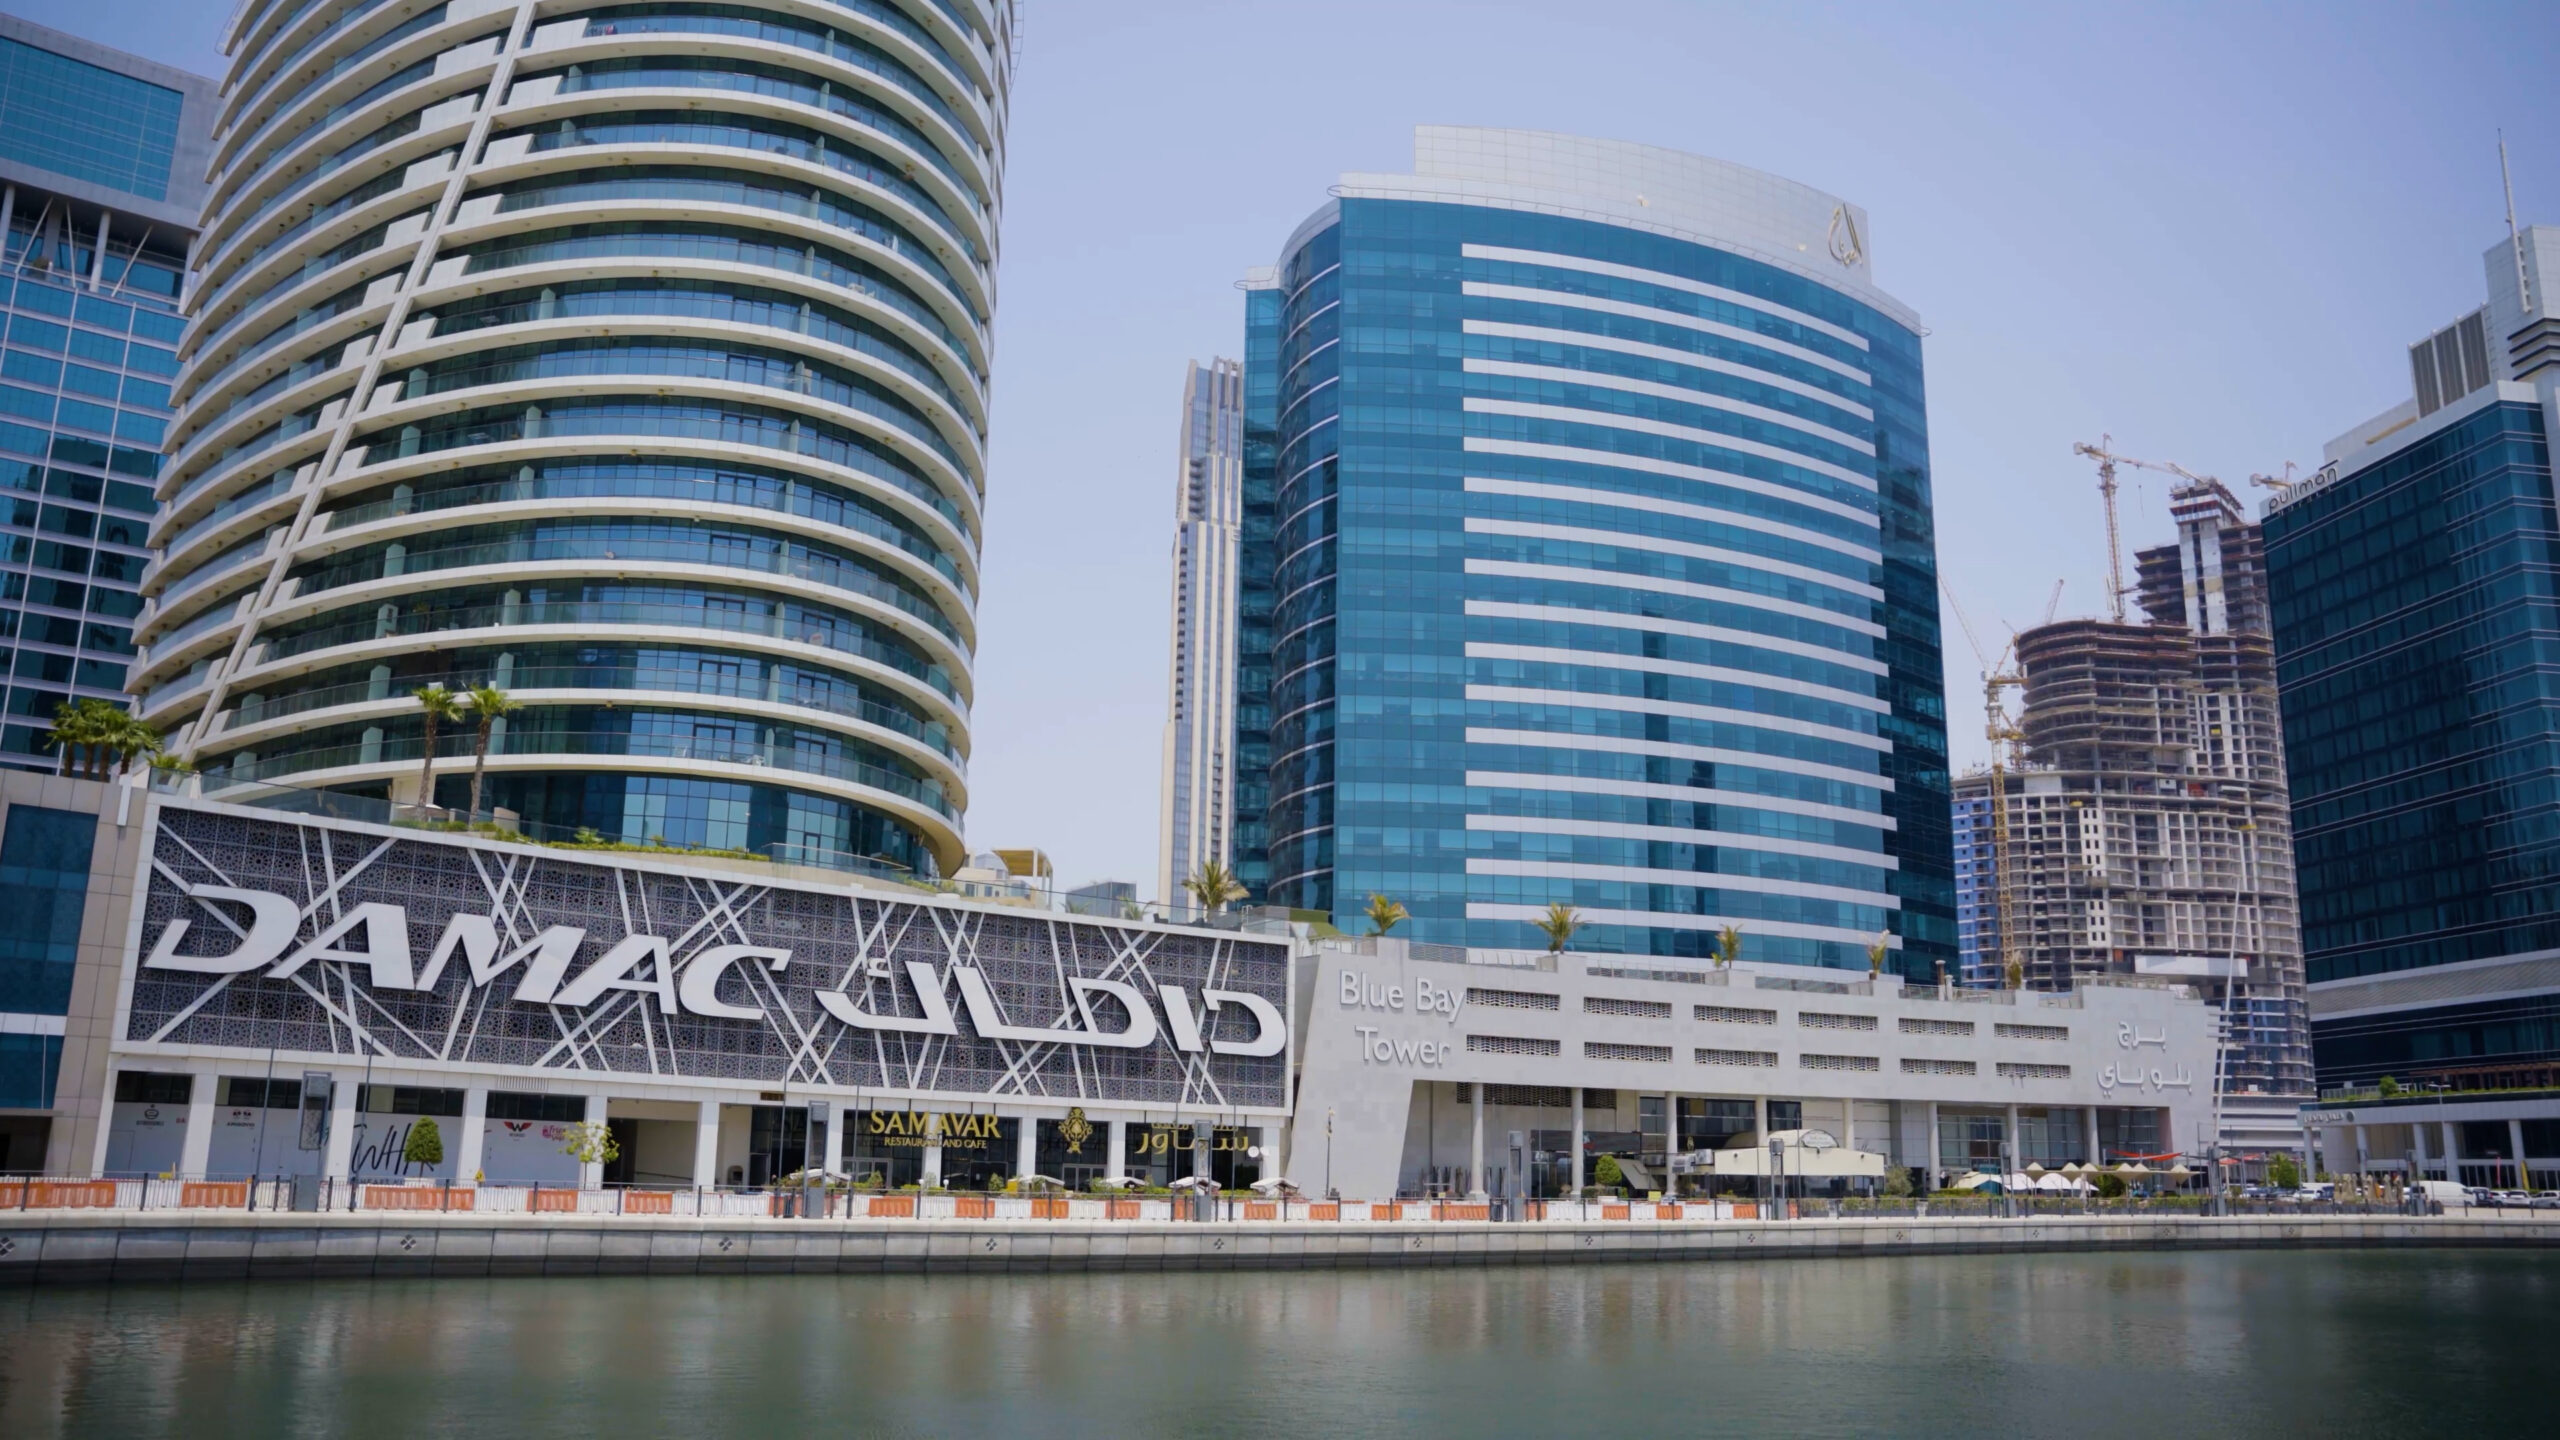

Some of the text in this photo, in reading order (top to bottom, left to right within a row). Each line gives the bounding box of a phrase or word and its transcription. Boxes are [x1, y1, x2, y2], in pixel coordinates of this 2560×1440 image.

[2268, 468, 2338, 515] pullman
[143, 883, 793, 1020] DAMAC
[814, 958, 1287, 1057] داماك
[1340, 969, 1465, 1024] Blue Bay
[1355, 1025, 1450, 1068] Tower
[2117, 1020, 2167, 1052] برج
[2097, 1060, 2193, 1098] بلو باي
[870, 1109, 1001, 1138] SAMAVAR
[943, 1139, 962, 1148] AND
[964, 1139, 987, 1149] CAFE
